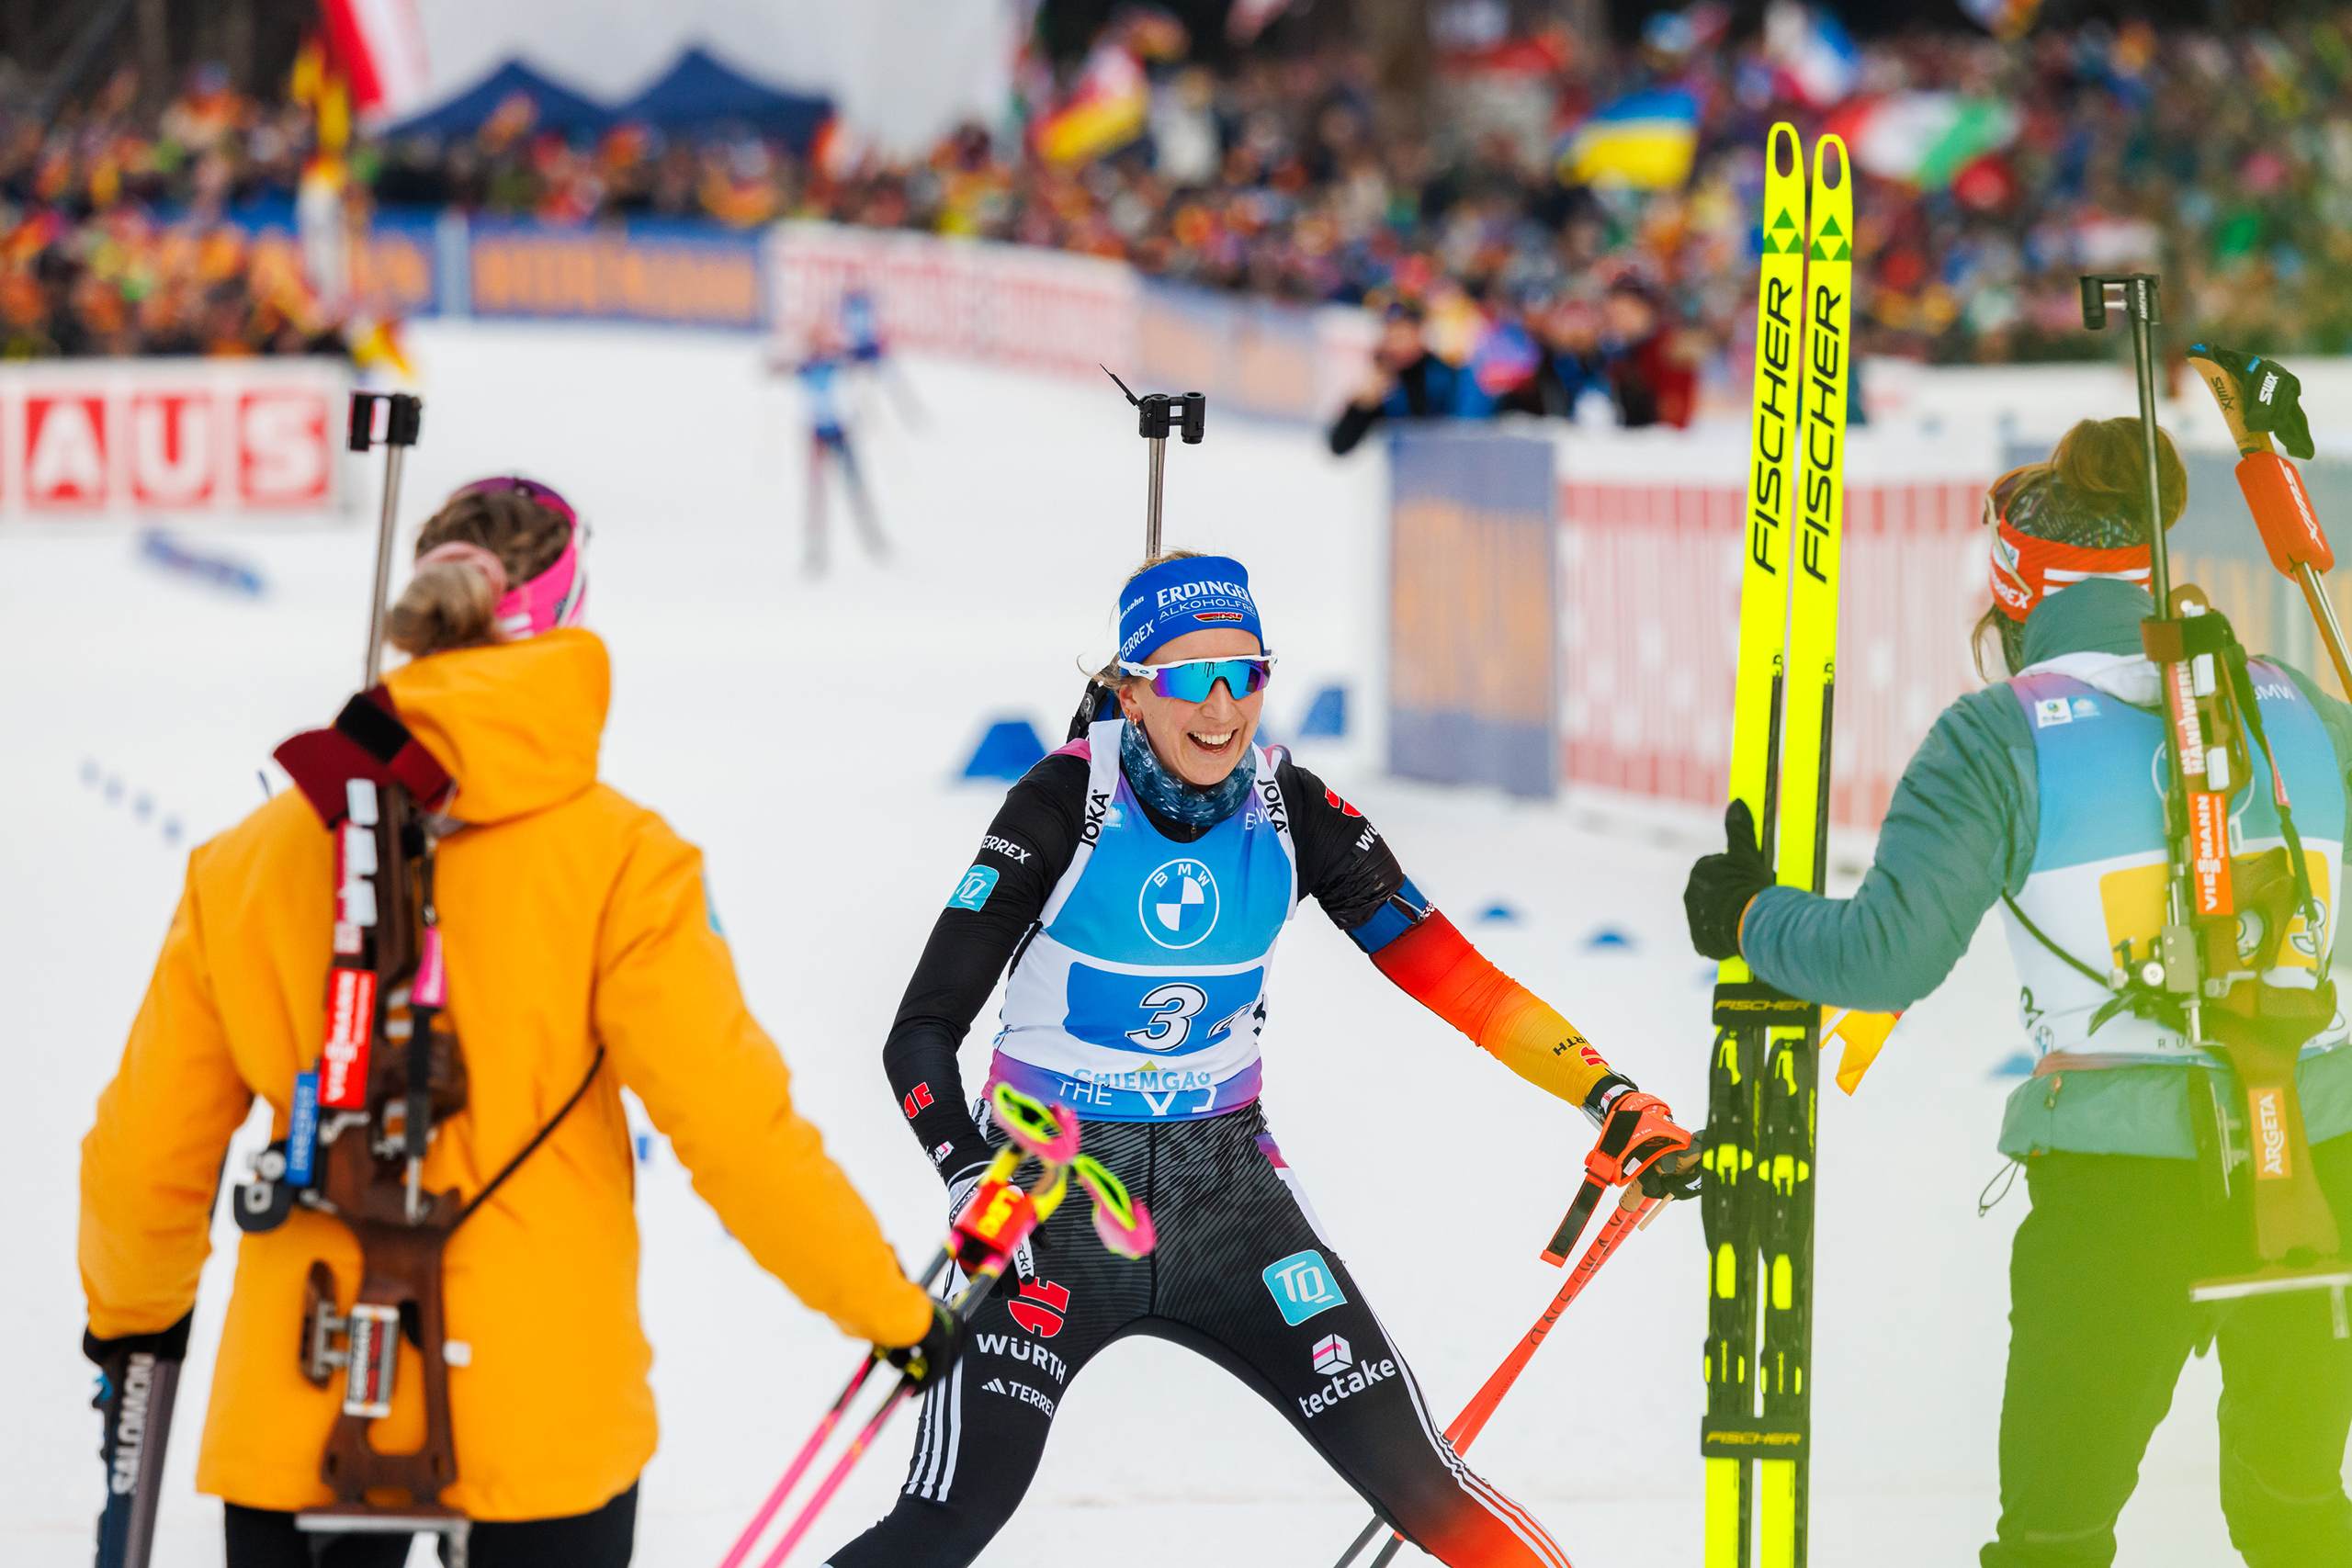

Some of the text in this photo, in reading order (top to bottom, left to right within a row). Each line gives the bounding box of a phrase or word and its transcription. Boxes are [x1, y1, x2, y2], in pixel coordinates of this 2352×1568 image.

[26, 395, 327, 508] AUS
[1752, 276, 1794, 576] FISCHER
[1803, 285, 1842, 584] FISCHER
[1156, 580, 1254, 608] ERDINGER
[1159, 598, 1257, 621] ALKOHOLFREI
[1120, 618, 1156, 660] TERREX
[1079, 792, 1110, 852] JOKA
[1257, 778, 1288, 835] JOKA
[1152, 863, 1211, 888] BMW
[2196, 795, 2222, 911] VIESSMANN
[1125, 982, 1209, 1053] 3
[1713, 998, 1811, 1011] FISCHER
[1058, 1079, 1113, 1107] THE
[2258, 1093, 2285, 1176] ARGETA
[1274, 1260, 1335, 1304] TQ
[976, 1333, 1068, 1386] WÜRTH
[1008, 1380, 1056, 1420] TERREX
[1297, 1358, 1397, 1419] tectake
[1705, 1430, 1803, 1447] FISCHER
